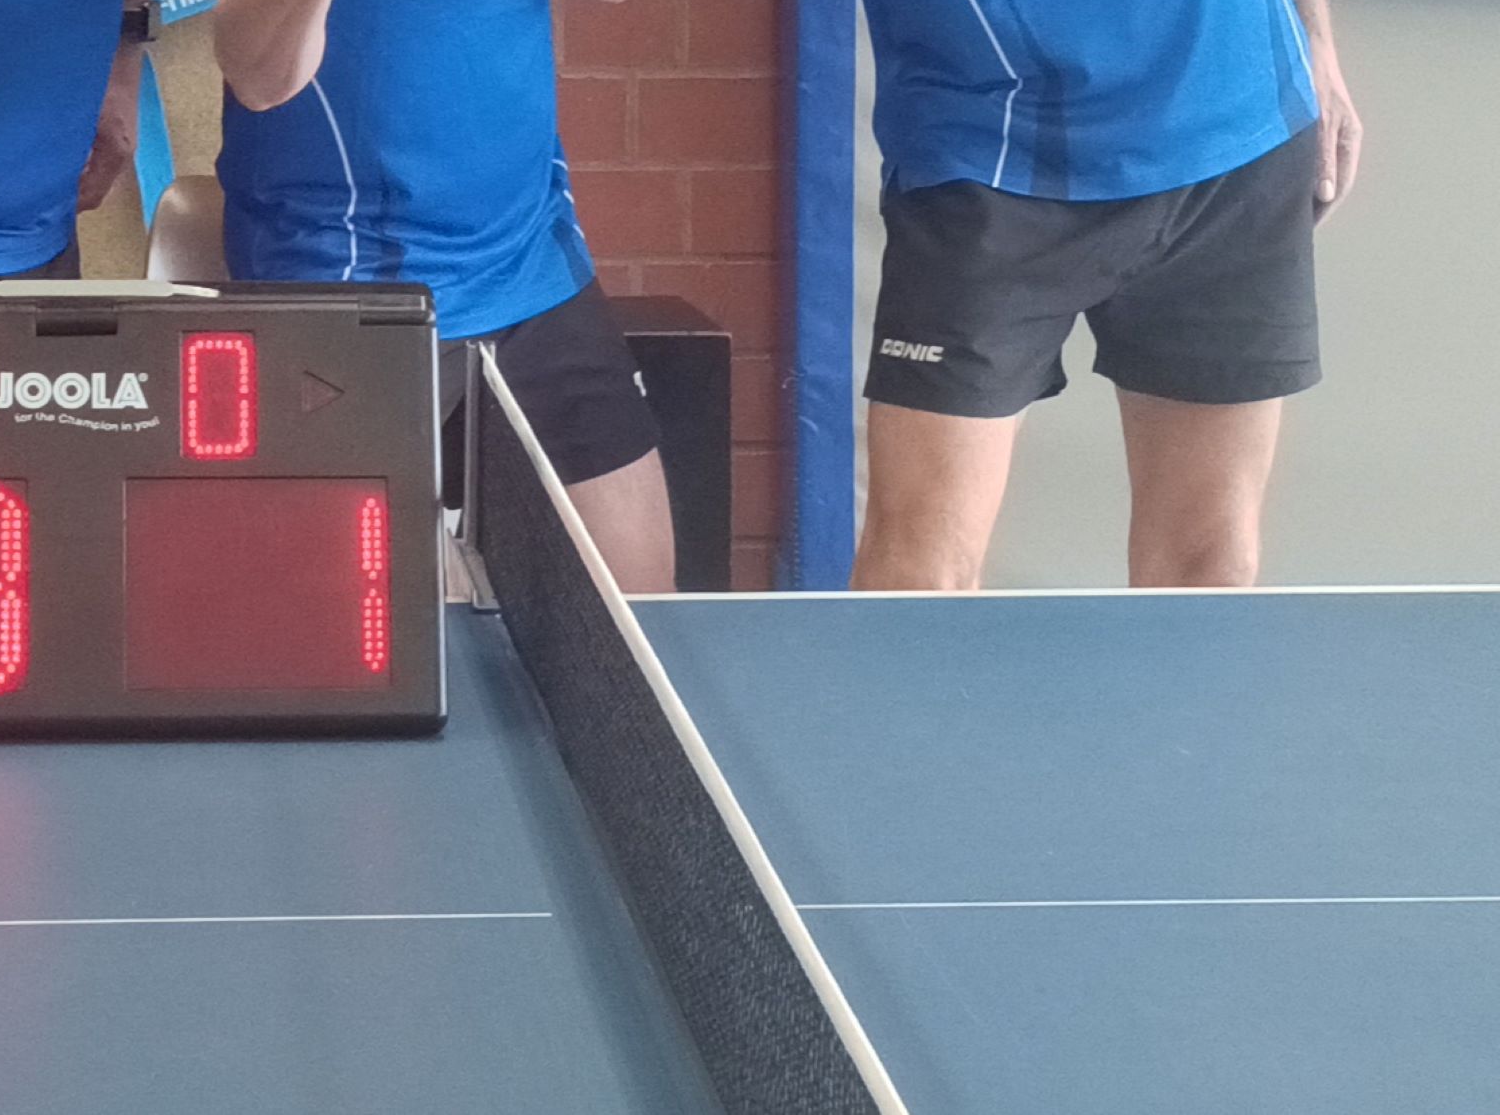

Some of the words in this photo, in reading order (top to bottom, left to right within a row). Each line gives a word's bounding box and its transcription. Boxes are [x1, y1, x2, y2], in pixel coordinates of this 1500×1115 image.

[880, 338, 944, 363] DONIC
[35, 412, 55, 422] the
[58, 413, 119, 432] Champion
[187, 339, 250, 455] 0
[360, 496, 386, 672] 1
